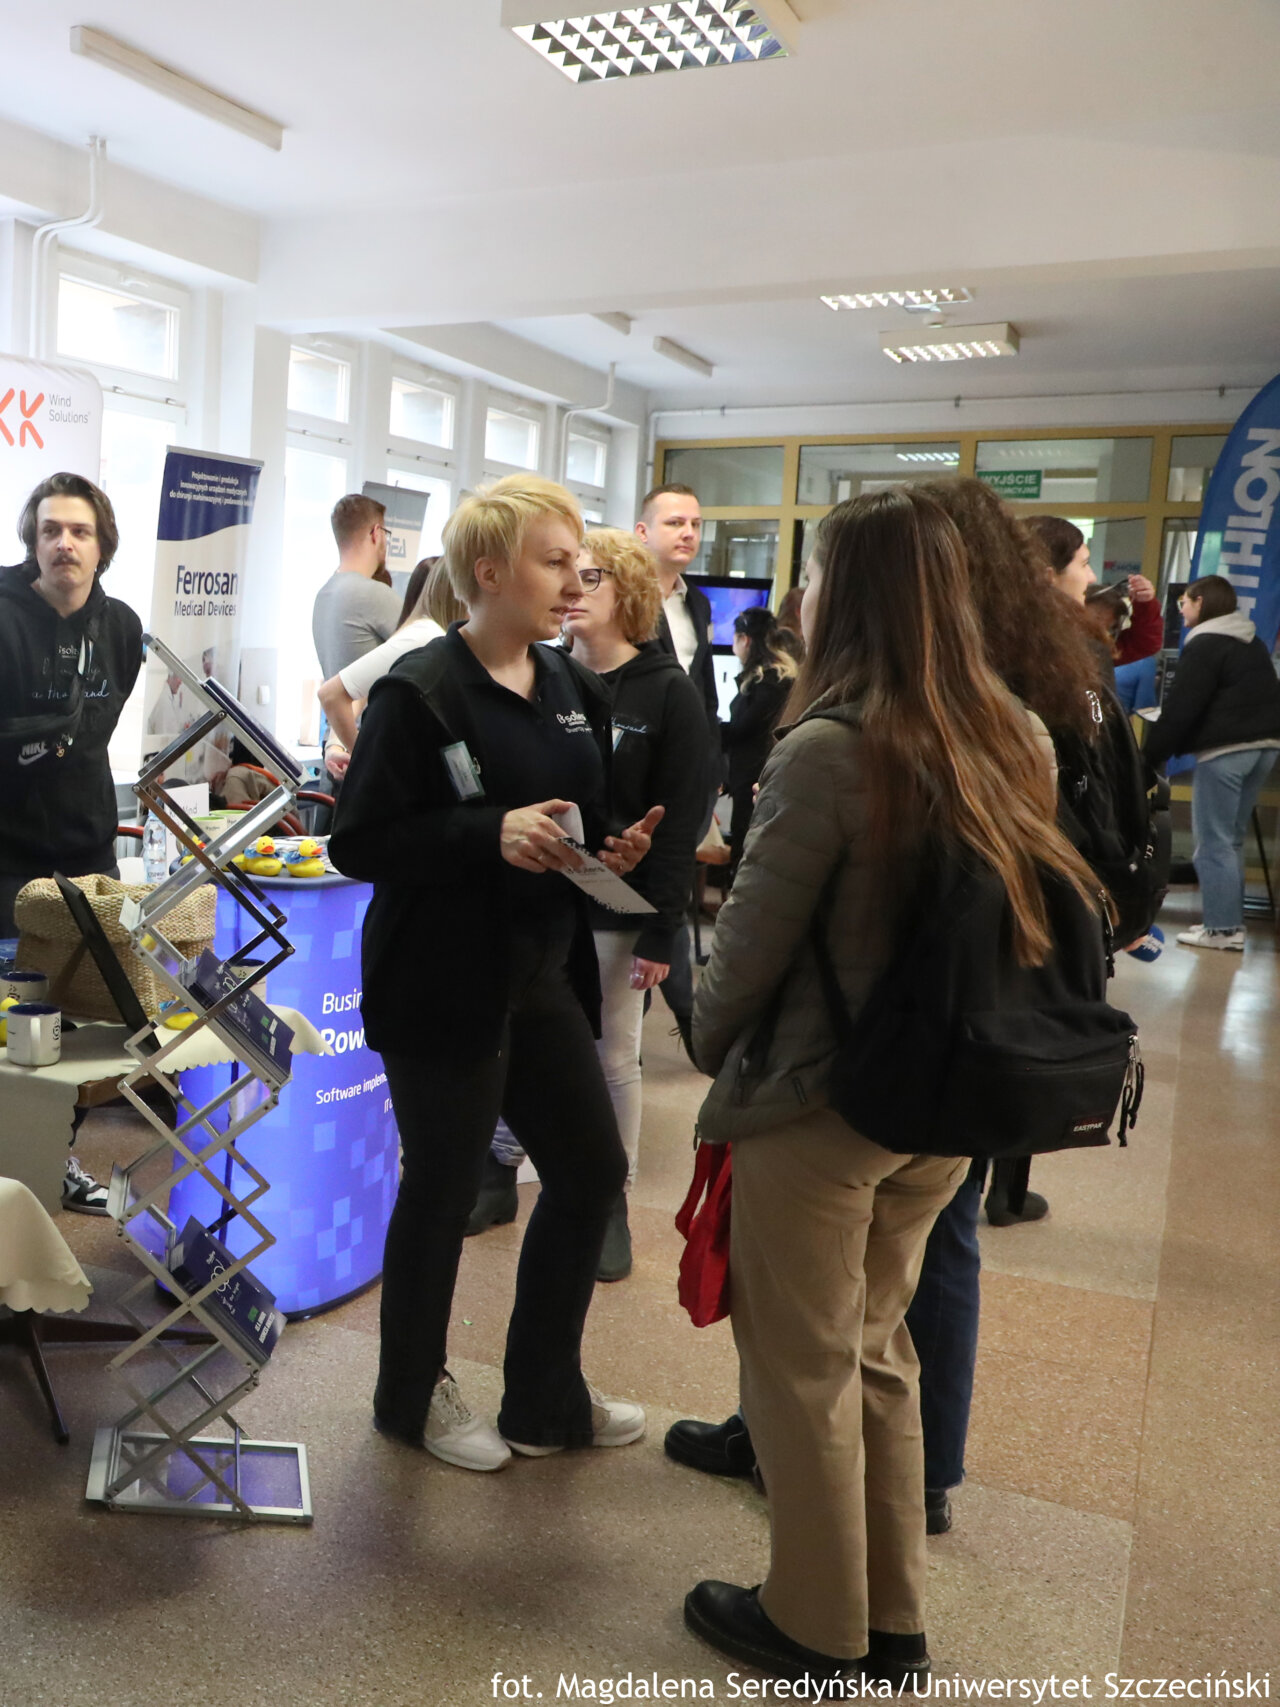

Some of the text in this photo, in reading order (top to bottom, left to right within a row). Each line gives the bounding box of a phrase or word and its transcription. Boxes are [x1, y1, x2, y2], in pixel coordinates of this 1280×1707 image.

[49, 393, 72, 407] Wind
[49, 409, 89, 424] Solutions
[1217, 427, 1280, 620] THLON
[176, 565, 238, 595] Ferrosan
[174, 601, 237, 617] Medical Devices
[21, 741, 46, 756] NIKE
[315, 1084, 362, 1105] Software
[1073, 1121, 1104, 1132] EASTPAK
